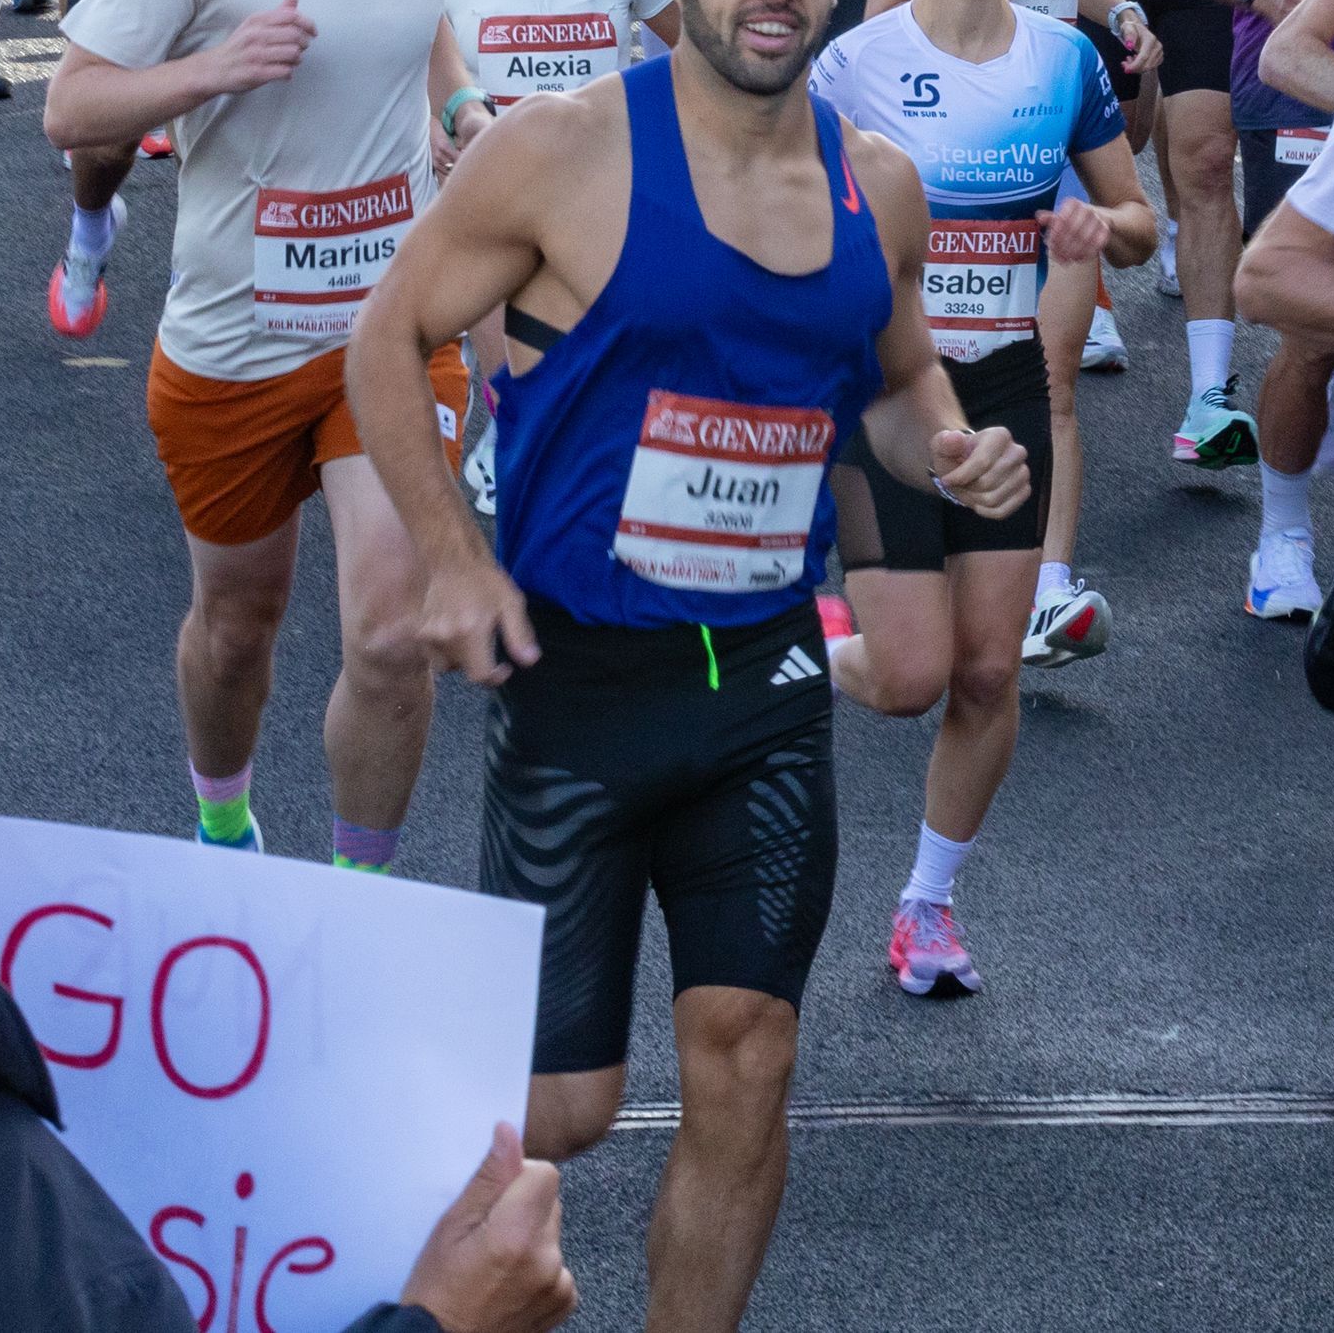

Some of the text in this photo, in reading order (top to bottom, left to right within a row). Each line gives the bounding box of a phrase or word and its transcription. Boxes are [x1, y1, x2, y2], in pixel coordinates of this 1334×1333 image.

[512, 20, 613, 45] GENERALI
[507, 55, 592, 79] Alexia
[902, 110, 919, 118] TEN
[921, 110, 937, 119] SUB
[923, 142, 1067, 166] SteuerWerk
[940, 166, 1035, 183] NeckarAlb
[300, 186, 409, 229] GENERALI
[285, 236, 396, 270] Marius
[929, 231, 1037, 254] GENERALI
[944, 302, 985, 315] 33249
[295, 318, 349, 333] MARATHON
[937, 345, 967, 358] ATHON
[698, 415, 830, 456] GENERALI
[686, 466, 780, 506] Juan
[0, 903, 271, 1099] GO
